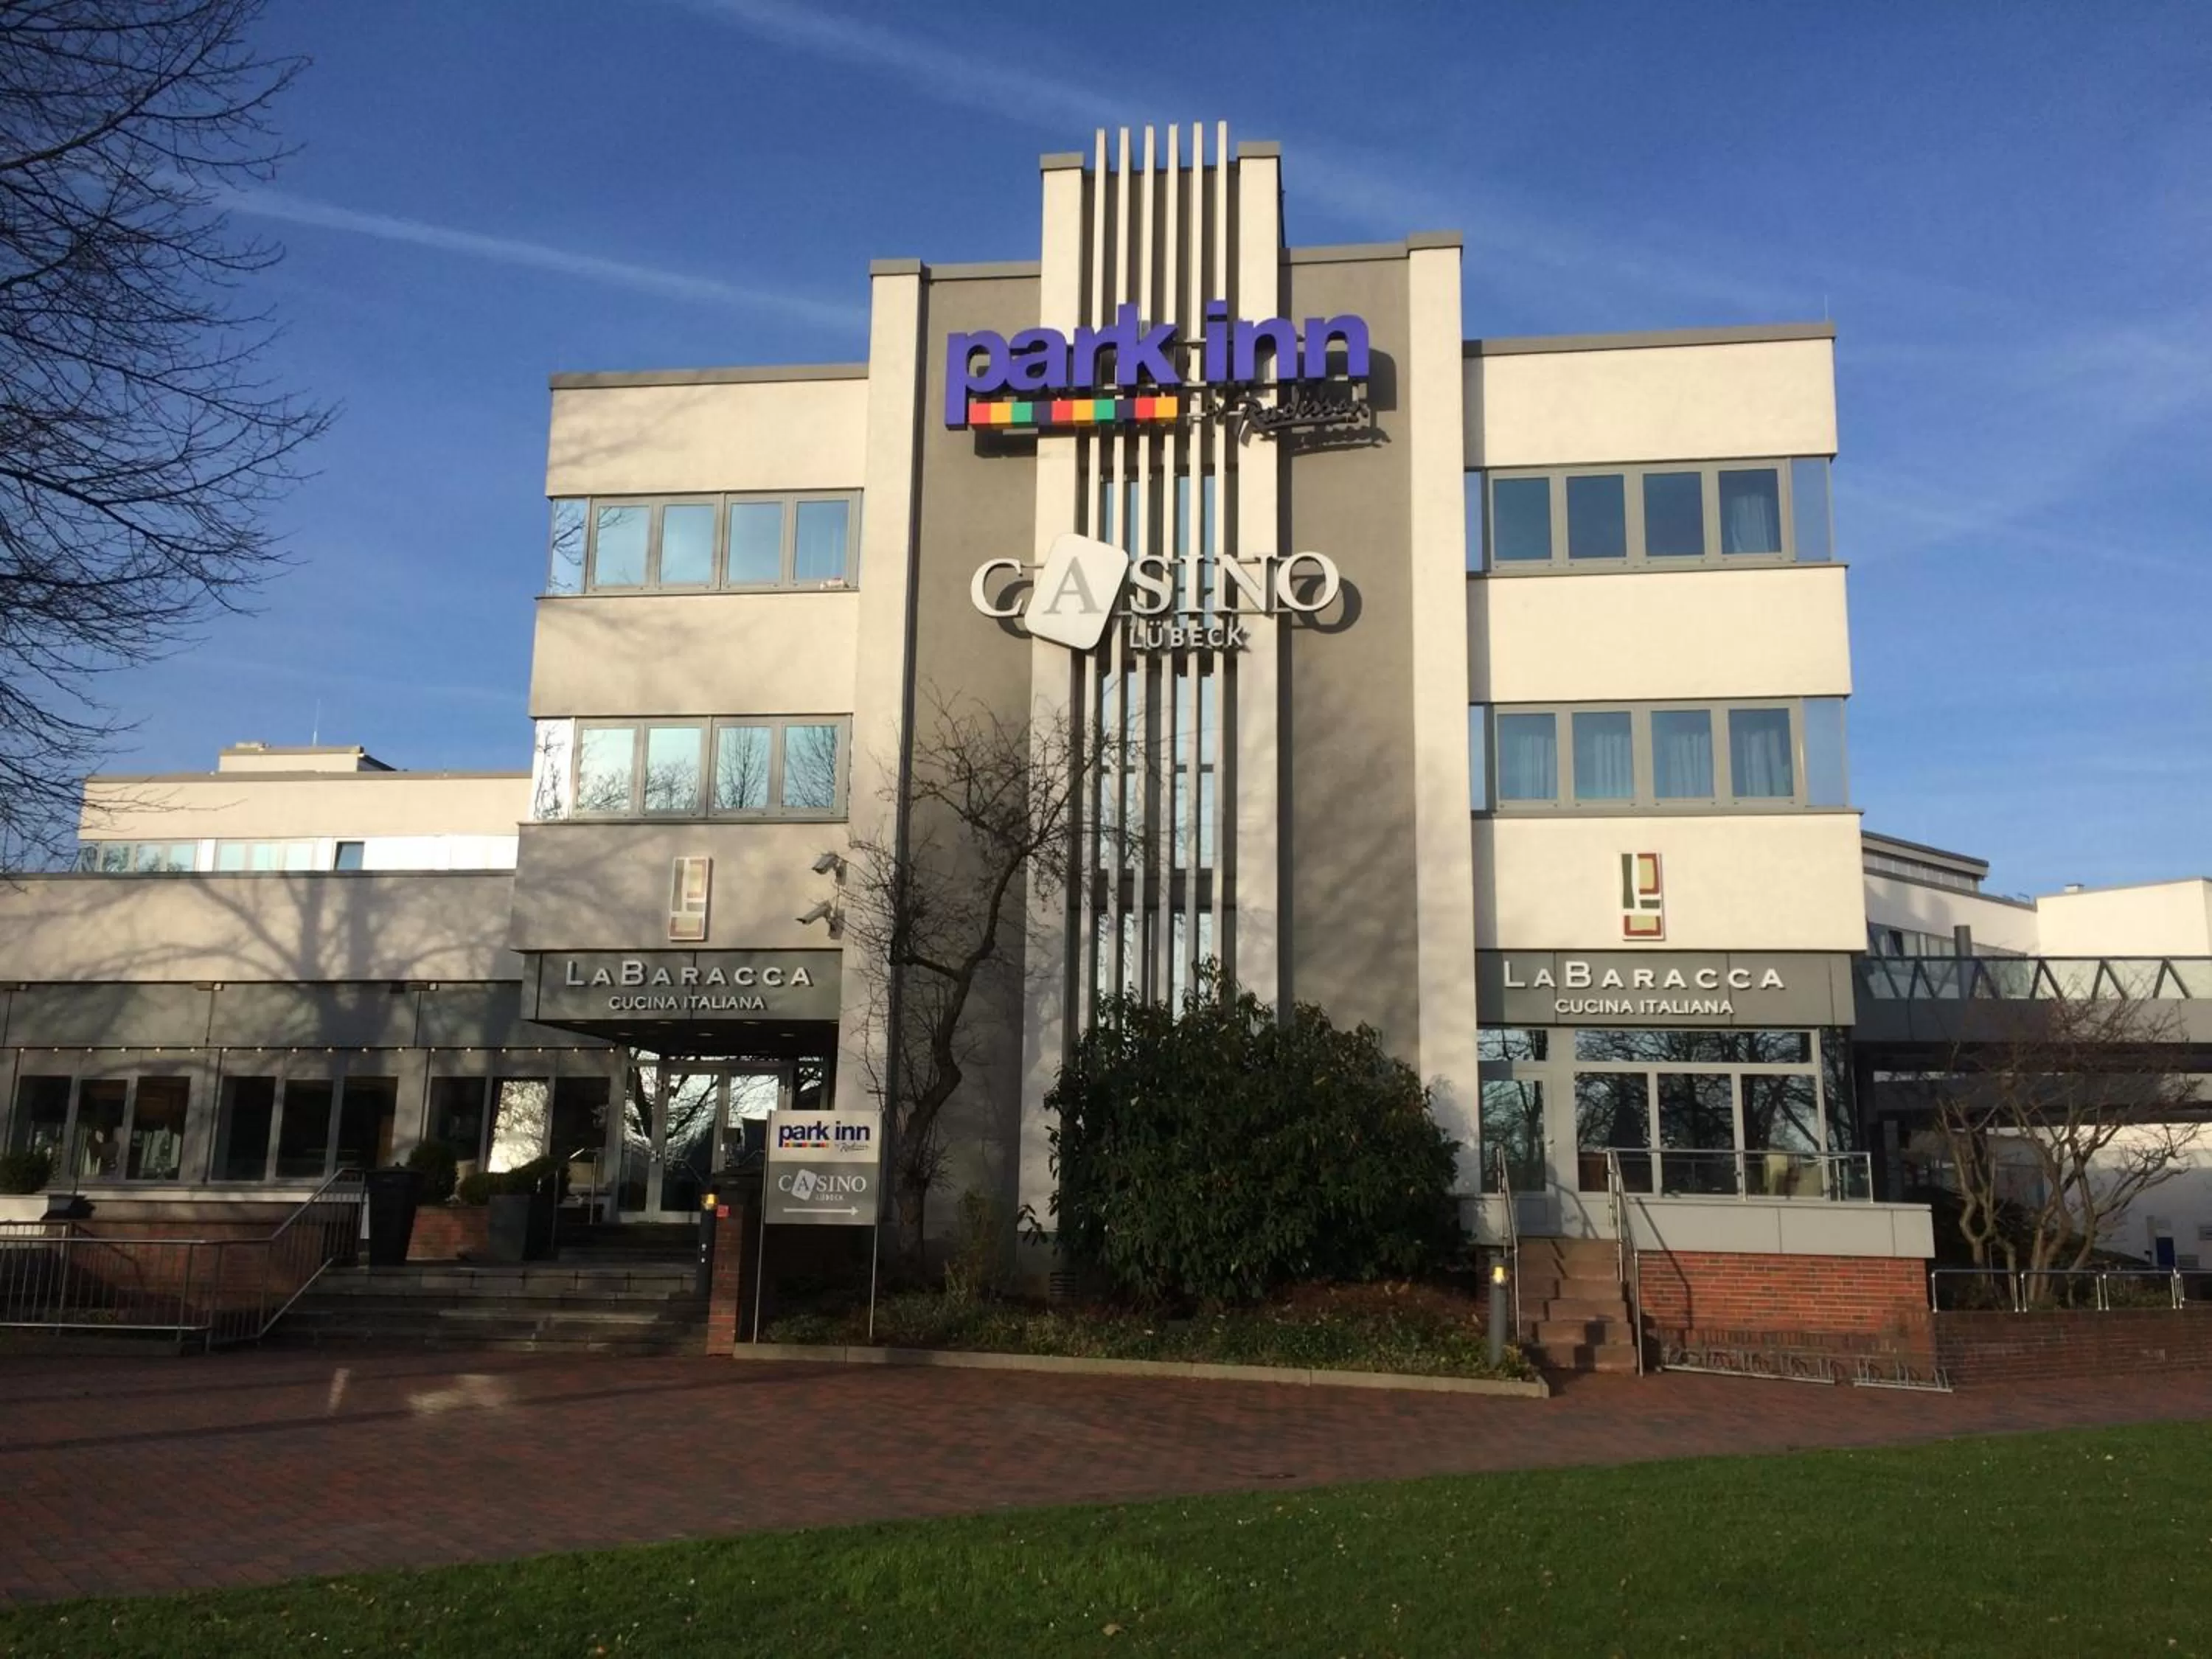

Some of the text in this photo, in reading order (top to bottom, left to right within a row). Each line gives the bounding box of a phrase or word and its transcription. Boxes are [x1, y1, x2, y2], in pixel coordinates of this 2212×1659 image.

[945, 299, 1370, 431] park inn
[970, 551, 1340, 617] CASINO
[1129, 620, 1243, 648] LÜBECK
[608, 995, 767, 1010] CUCINA ITALIANA
[1554, 998, 1735, 1015] CUCINA ITALIANA
[779, 1121, 830, 1147] park
[835, 1121, 871, 1141] inn
[779, 1175, 866, 1192] CASINO
